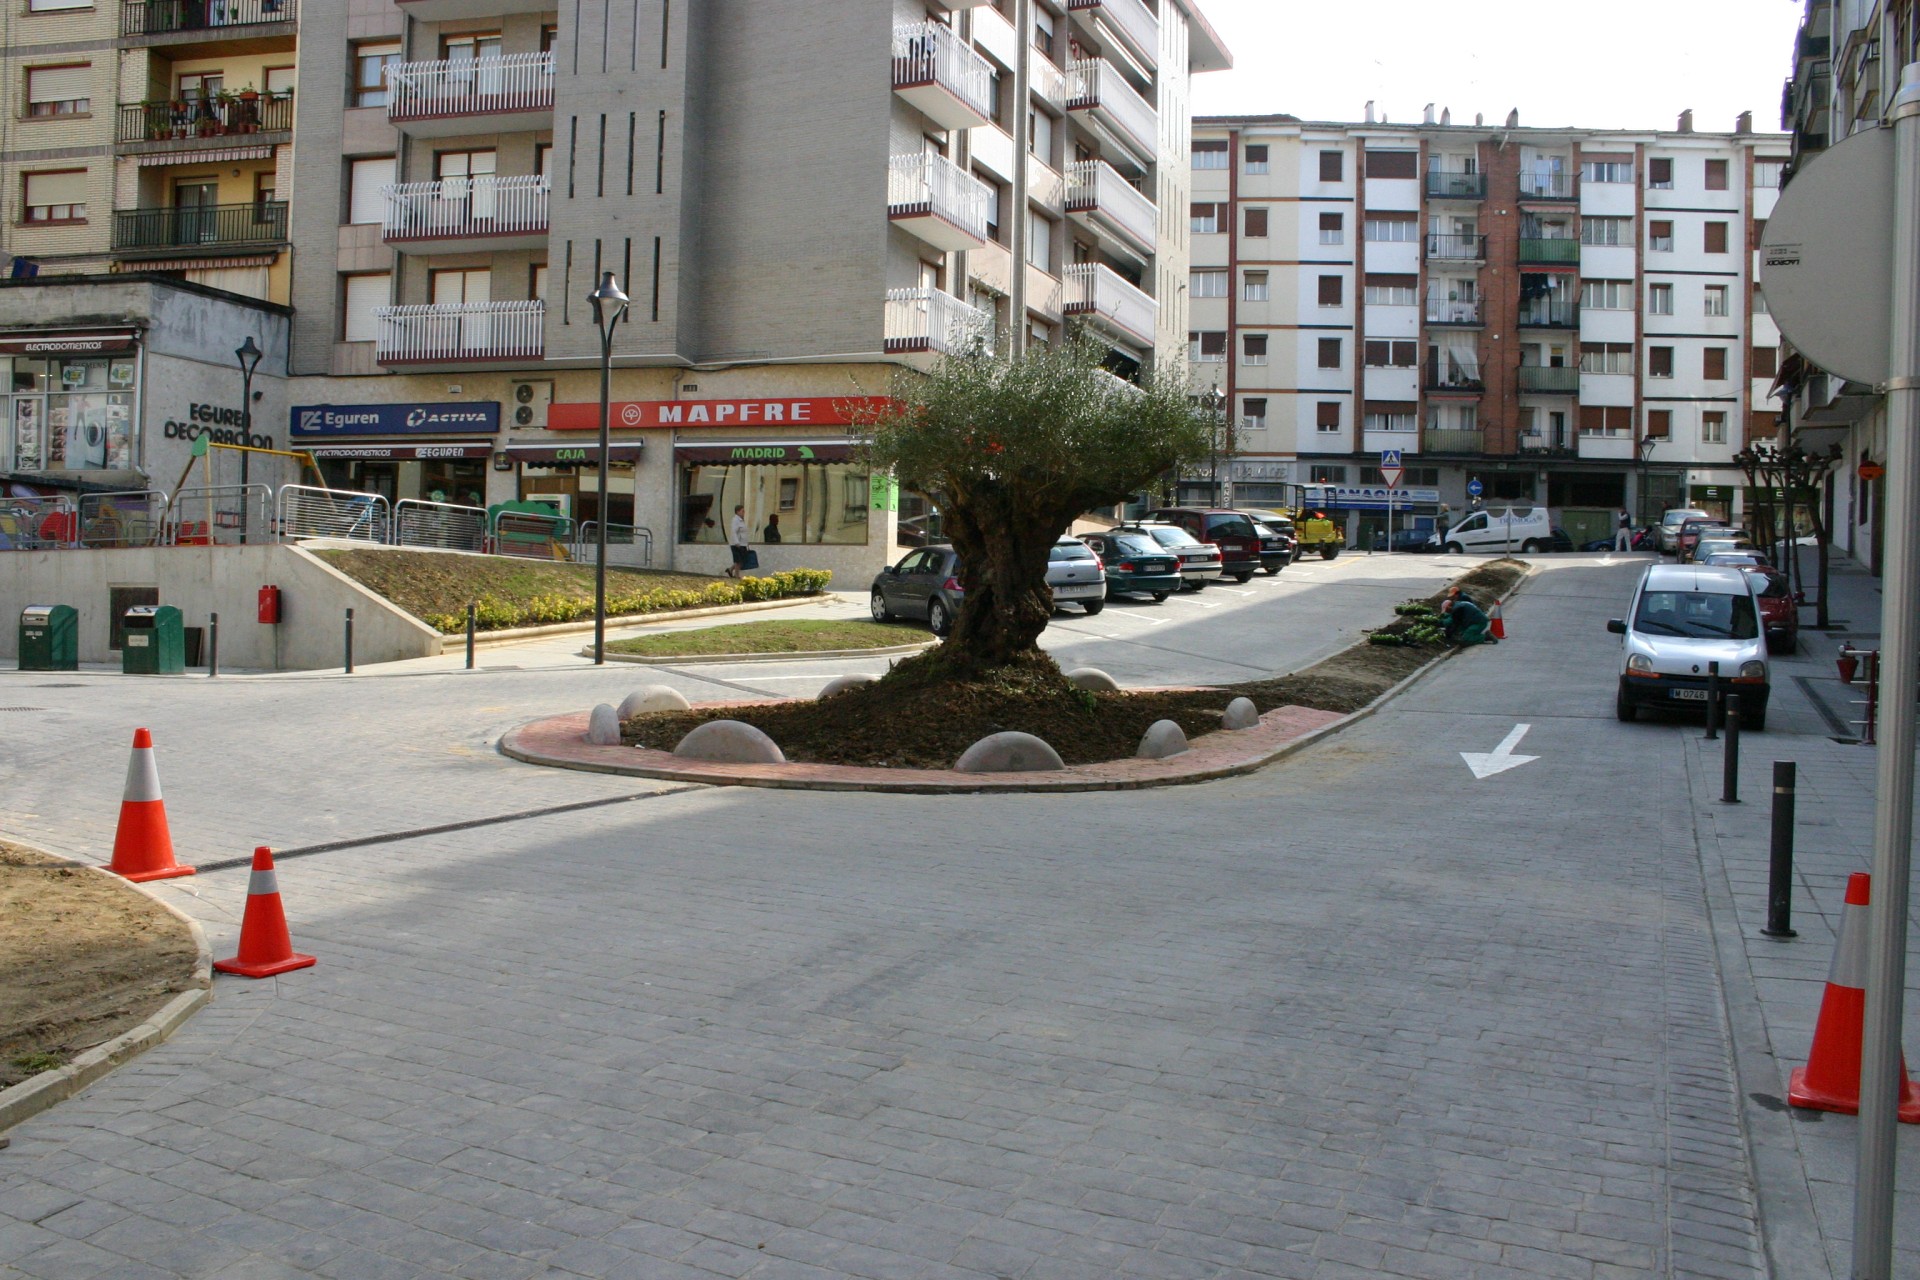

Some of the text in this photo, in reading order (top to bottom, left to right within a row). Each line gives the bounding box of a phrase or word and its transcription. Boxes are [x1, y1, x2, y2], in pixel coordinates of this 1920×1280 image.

[25, 341, 102, 351] ELECTRODOMESTICOS
[428, 413, 487, 422] ACTIVA
[659, 402, 811, 423] MAPFRE
[325, 412, 379, 428] Eguren
[315, 449, 391, 457] ELECTRODOMESTICOS
[556, 449, 586, 459] CAJA
[731, 448, 785, 459] MADRID
[1683, 690, 1705, 699] 0746
